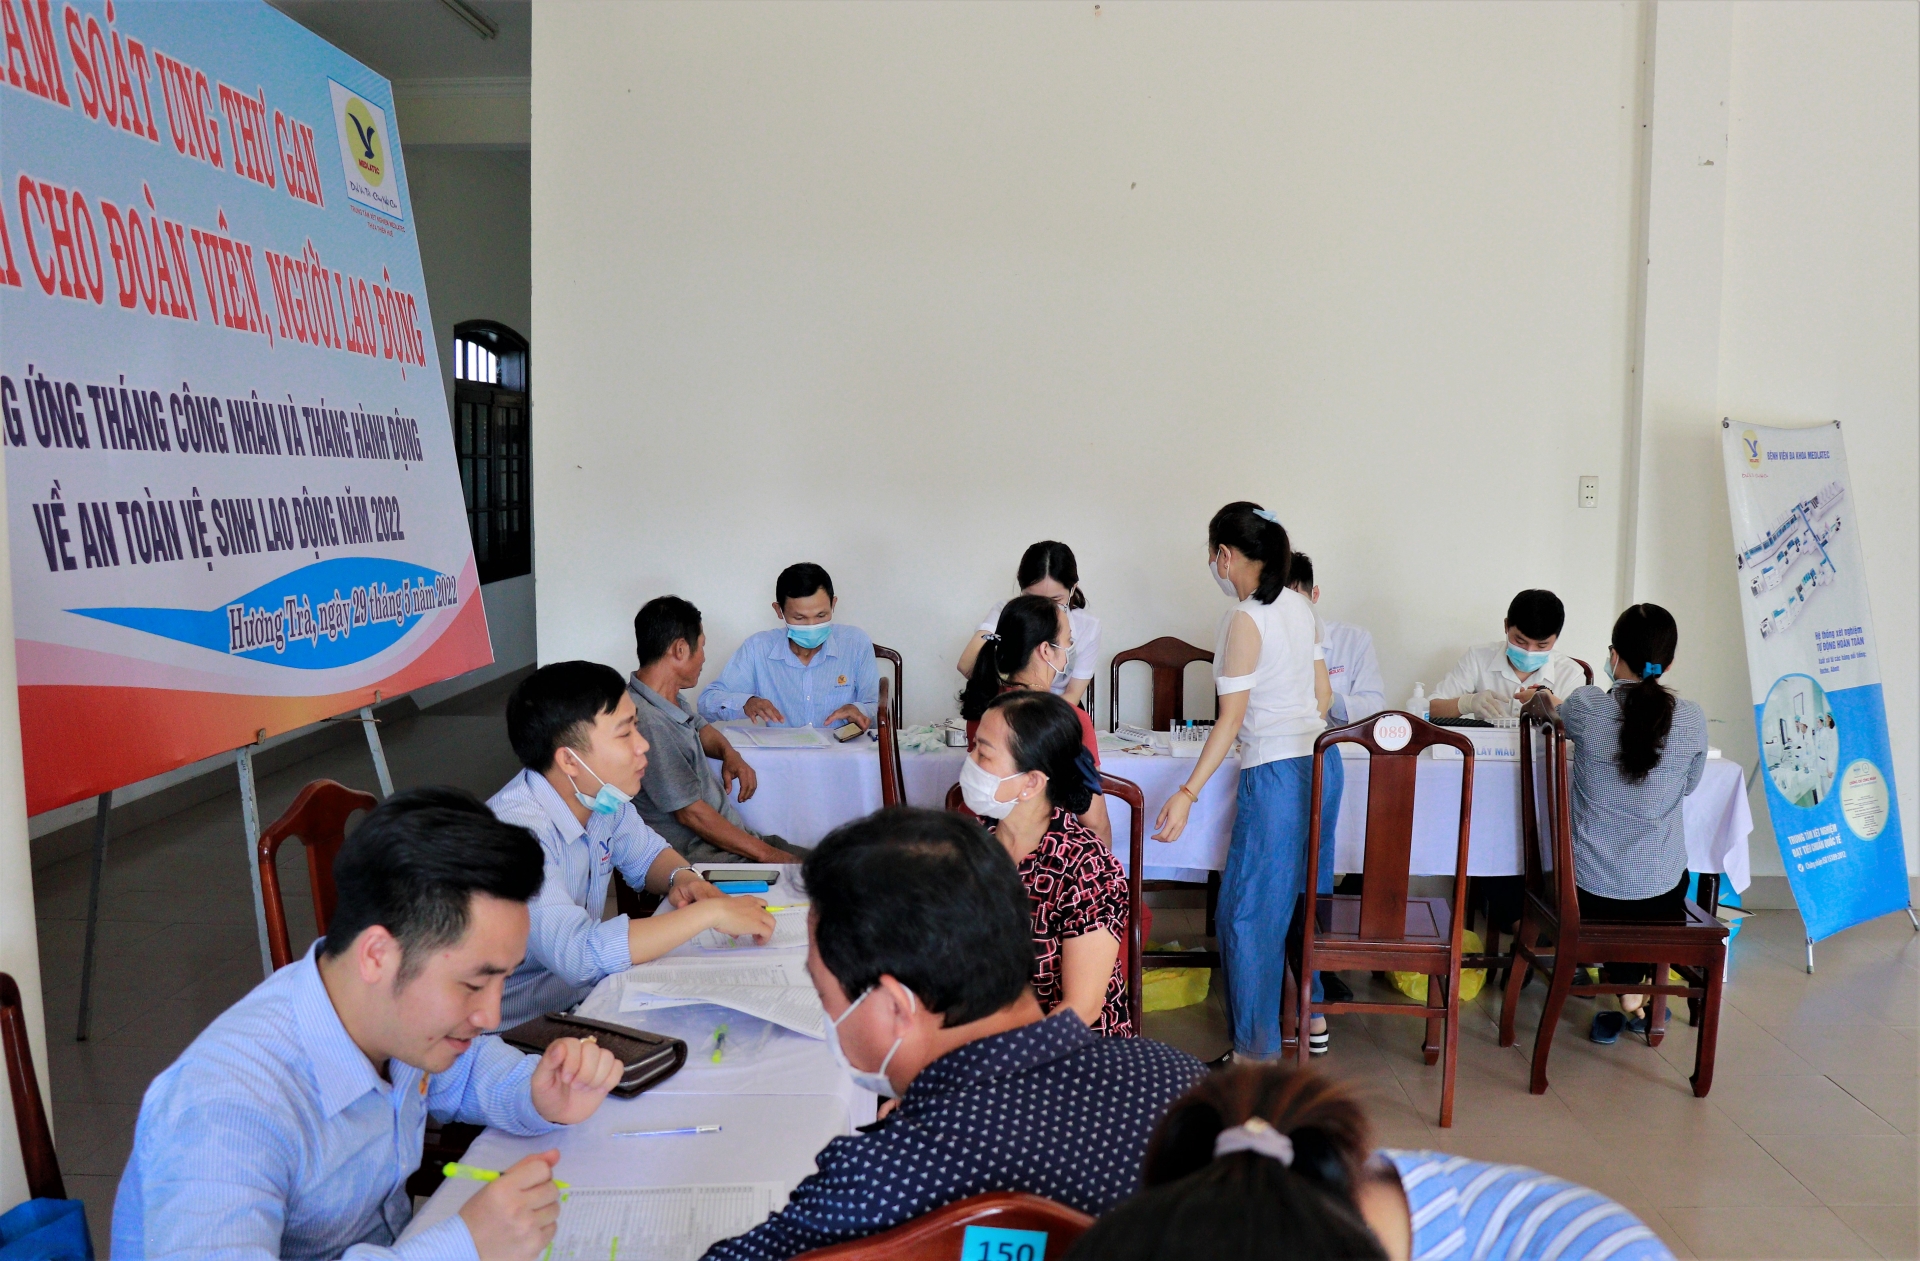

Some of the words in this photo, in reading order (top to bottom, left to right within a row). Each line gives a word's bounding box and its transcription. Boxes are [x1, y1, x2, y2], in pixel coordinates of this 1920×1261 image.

[65, 0, 159, 142] SOÁT
[154, 51, 224, 169] UNG
[218, 83, 275, 189] THƯ
[274, 110, 325, 208] GAN
[19, 174, 104, 306] CHO
[100, 182, 198, 322] ĐOÀN
[190, 208, 274, 350] VIÊN,
[265, 238, 342, 350] NGƯỜI
[334, 272, 377, 358] LAO
[372, 265, 427, 381] ĐỘNG
[24, 363, 91, 450] ỨNG
[86, 374, 172, 453] THÁNG
[169, 381, 230, 454] CÔNG
[226, 389, 282, 456] NHÂN
[277, 393, 306, 456] VÀ
[302, 397, 354, 459] THÁNG
[350, 402, 391, 460] HÀNH
[386, 407, 424, 471] ĐỘNG
[32, 479, 78, 572] VỀ
[77, 502, 120, 569] AN
[115, 487, 184, 565] TOÀN
[179, 486, 214, 572] VỆ
[210, 497, 262, 557] SINH
[257, 496, 295, 552] LAO
[291, 485, 340, 560] ĐỘNG
[335, 485, 374, 545] NĂM
[370, 495, 406, 543] 2022
[229, 607, 285, 651] Hương
[285, 597, 317, 642] Trà,
[319, 591, 350, 640] ngày
[352, 589, 367, 625] 29
[369, 584, 403, 625] tháng
[403, 582, 411, 615] 5
[412, 582, 436, 613] năm
[435, 575, 458, 608] 2022
[1379, 726, 1407, 738] 089
[979, 1241, 1035, 1261] 150
